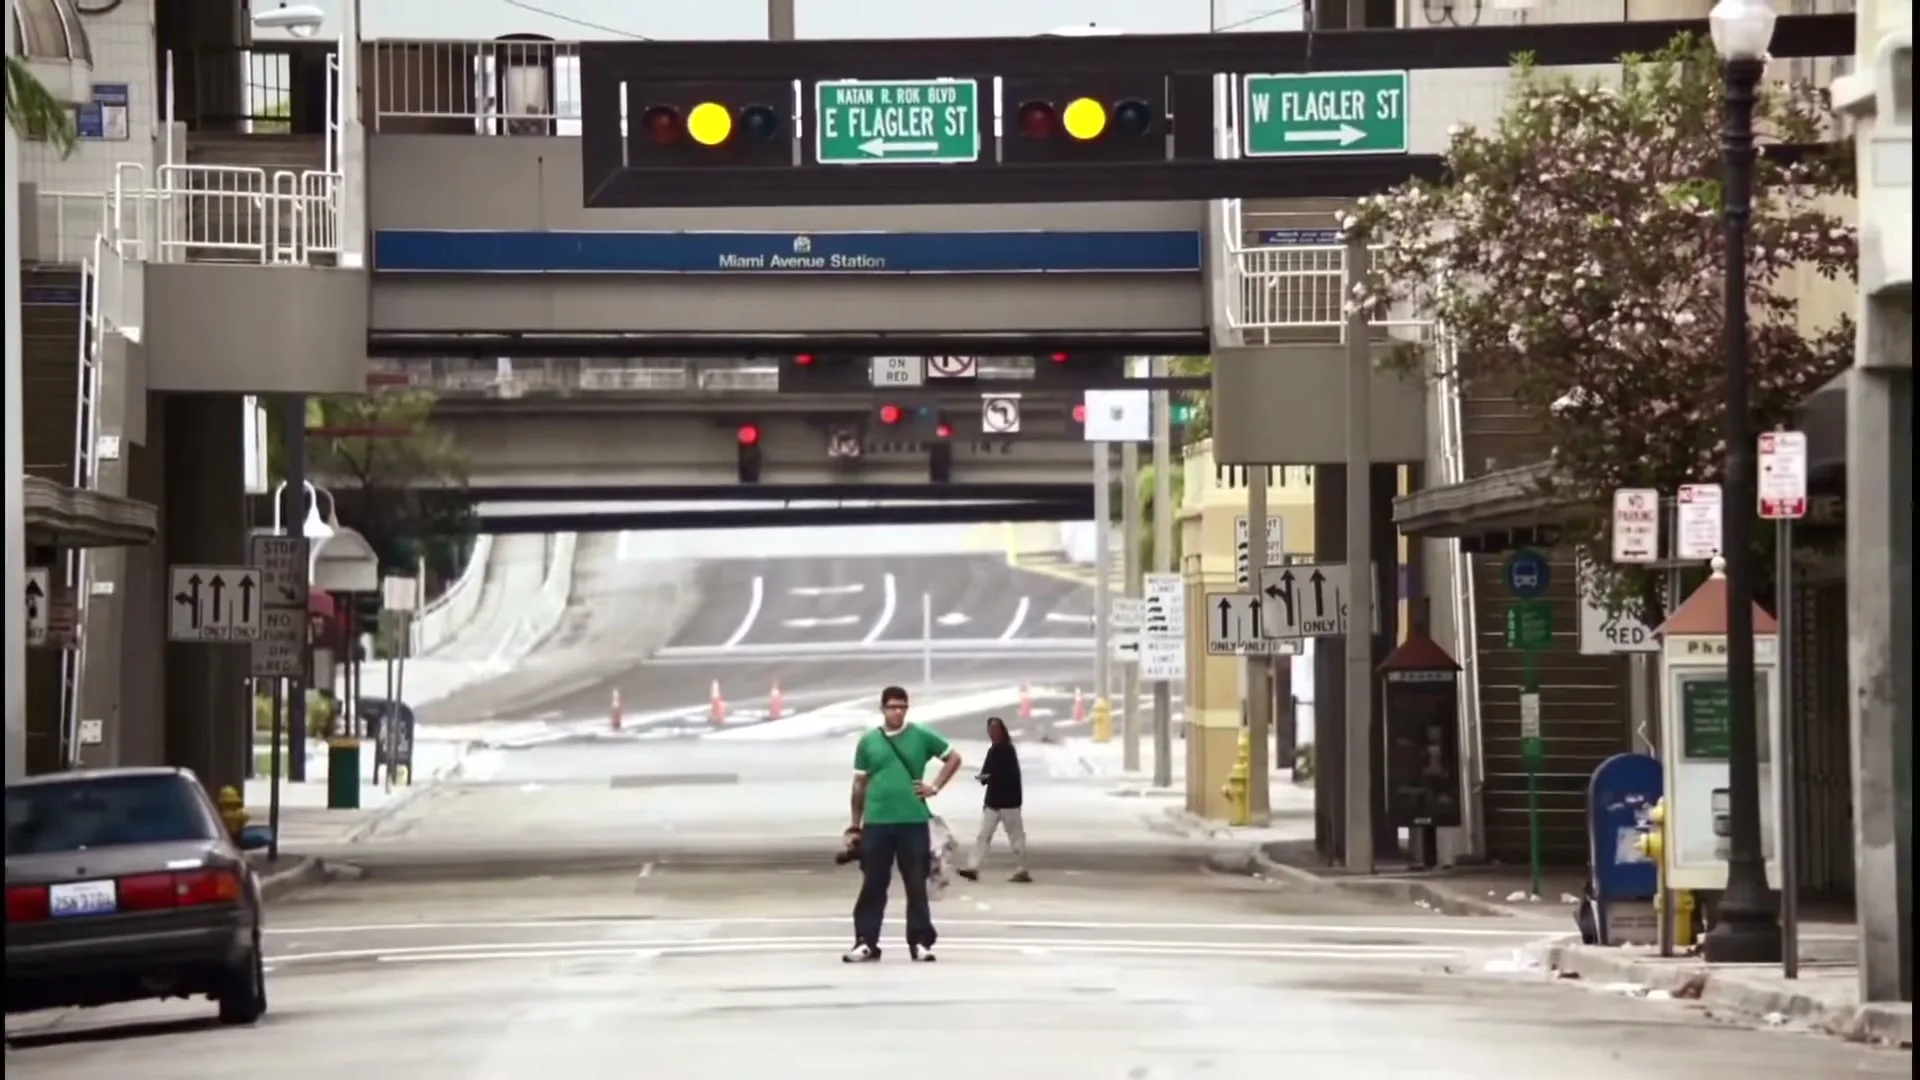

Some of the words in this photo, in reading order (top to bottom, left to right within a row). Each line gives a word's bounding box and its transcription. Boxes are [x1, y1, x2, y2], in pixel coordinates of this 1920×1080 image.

[836, 88, 874, 104] NATAN
[881, 88, 892, 104] R.
[896, 87, 920, 104] ROK
[928, 86, 956, 103] BLVD
[1252, 92, 1270, 123] W
[1281, 90, 1365, 122] FLAGLER
[1376, 88, 1400, 119] ST
[825, 108, 838, 137] E
[848, 106, 934, 137] FLAGLER
[944, 105, 968, 136] ST
[719, 253, 764, 268] Miami
[770, 254, 825, 268] Avenue
[830, 253, 886, 268] Station
[889, 359, 905, 368] ON
[886, 371, 909, 381] RED
[267, 613, 290, 627] NO
[1303, 620, 1335, 633] ONLY
[1605, 628, 1644, 644] RED
[1210, 641, 1236, 651] ONLY
[1688, 641, 1726, 653] Pho
